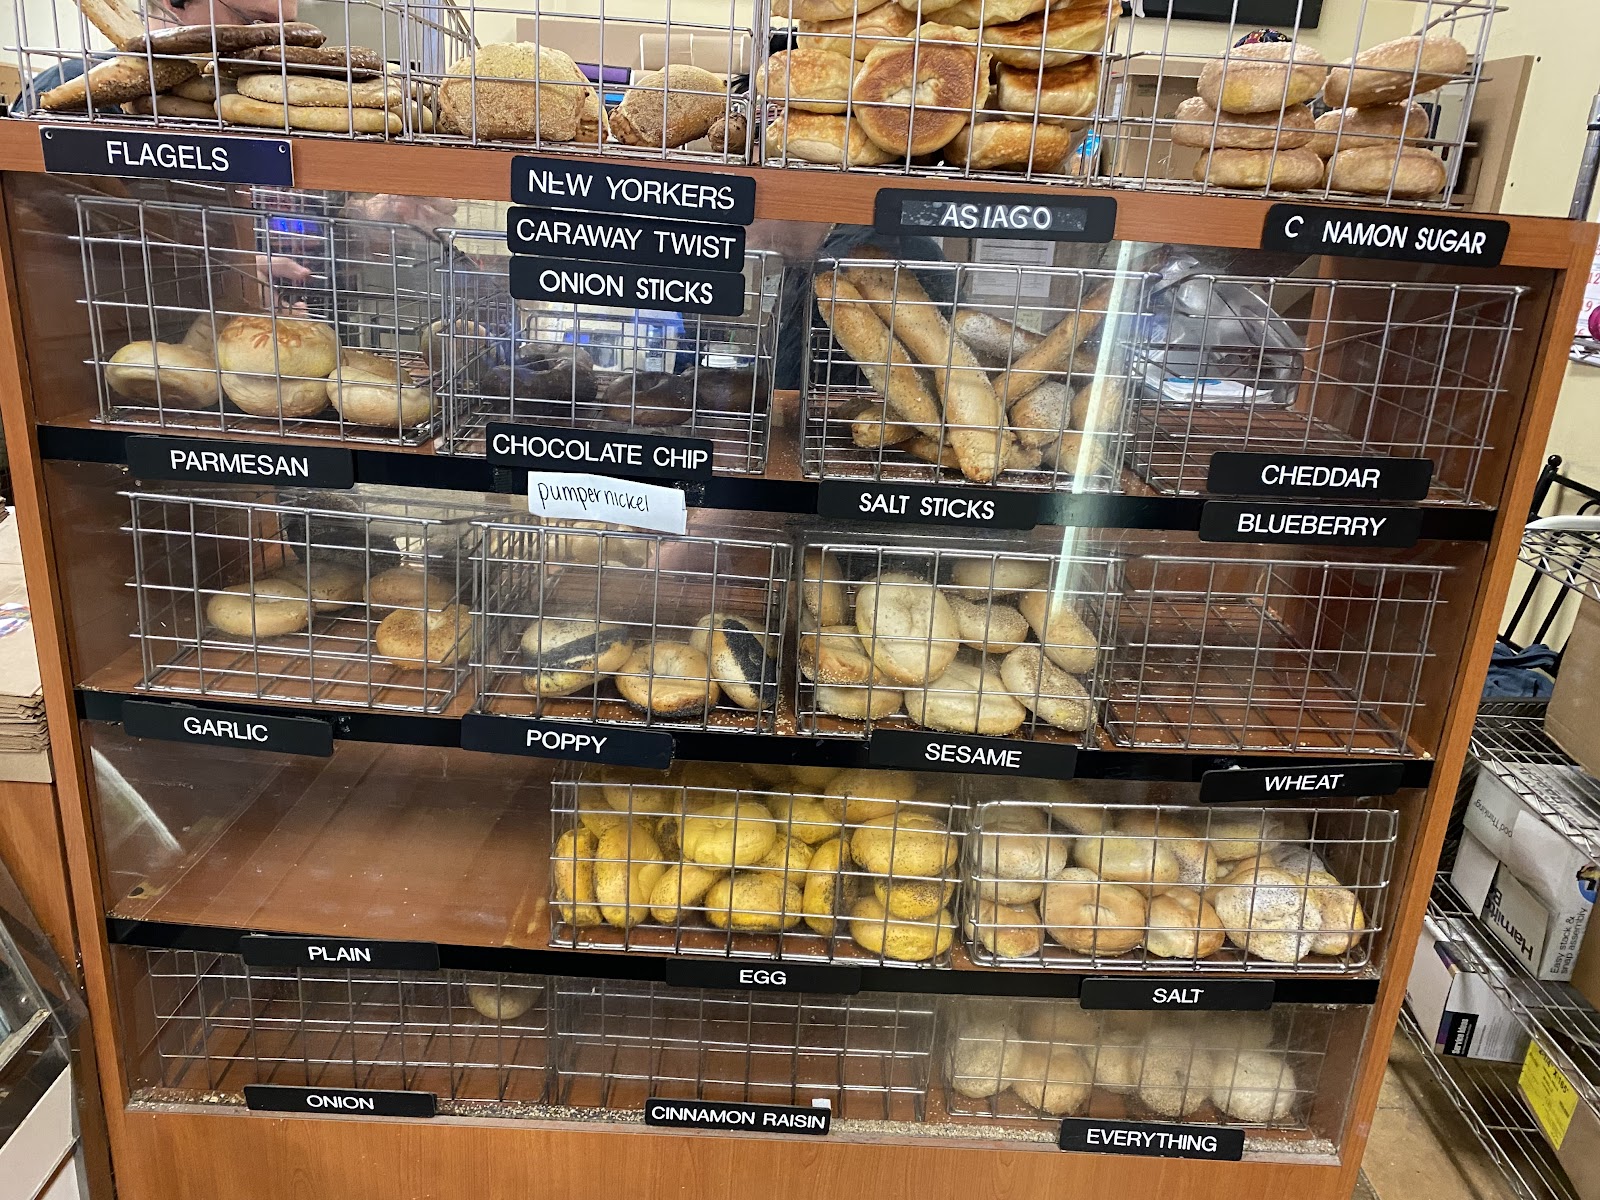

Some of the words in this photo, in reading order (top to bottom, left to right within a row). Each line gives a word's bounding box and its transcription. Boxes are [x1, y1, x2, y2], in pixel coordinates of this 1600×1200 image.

[105, 139, 231, 172] FLAGELS
[528, 169, 593, 197] NEW
[605, 177, 736, 211] YORKERS
[941, 202, 1053, 231] ASIAGO
[515, 218, 644, 252] CARAWAY
[653, 230, 737, 260] TWIST
[1414, 227, 1487, 255] SUGAR
[539, 269, 624, 298] ONION
[635, 277, 713, 305] STICKS
[170, 449, 309, 477] PARMESAN
[492, 433, 643, 466] CHOCOLATE
[653, 446, 708, 470] CHIP
[1261, 464, 1381, 489] CHEDDAR
[858, 492, 908, 515] SALT
[919, 496, 995, 520] STICKS
[1237, 512, 1387, 537] BLUEBERRY
[183, 716, 269, 742] GARLIC
[526, 729, 608, 754] POPPY
[924, 742, 1023, 769] SESAME
[1265, 773, 1345, 792] WHEAT
[307, 946, 371, 962] PLAIN
[739, 969, 787, 985] EGG
[1152, 987, 1205, 1004] SALT
[305, 1094, 375, 1111] ONION
[650, 1106, 756, 1127] CINNAMON
[762, 1112, 826, 1130] RAISIN
[1086, 1128, 1218, 1152] EVERYTHING
